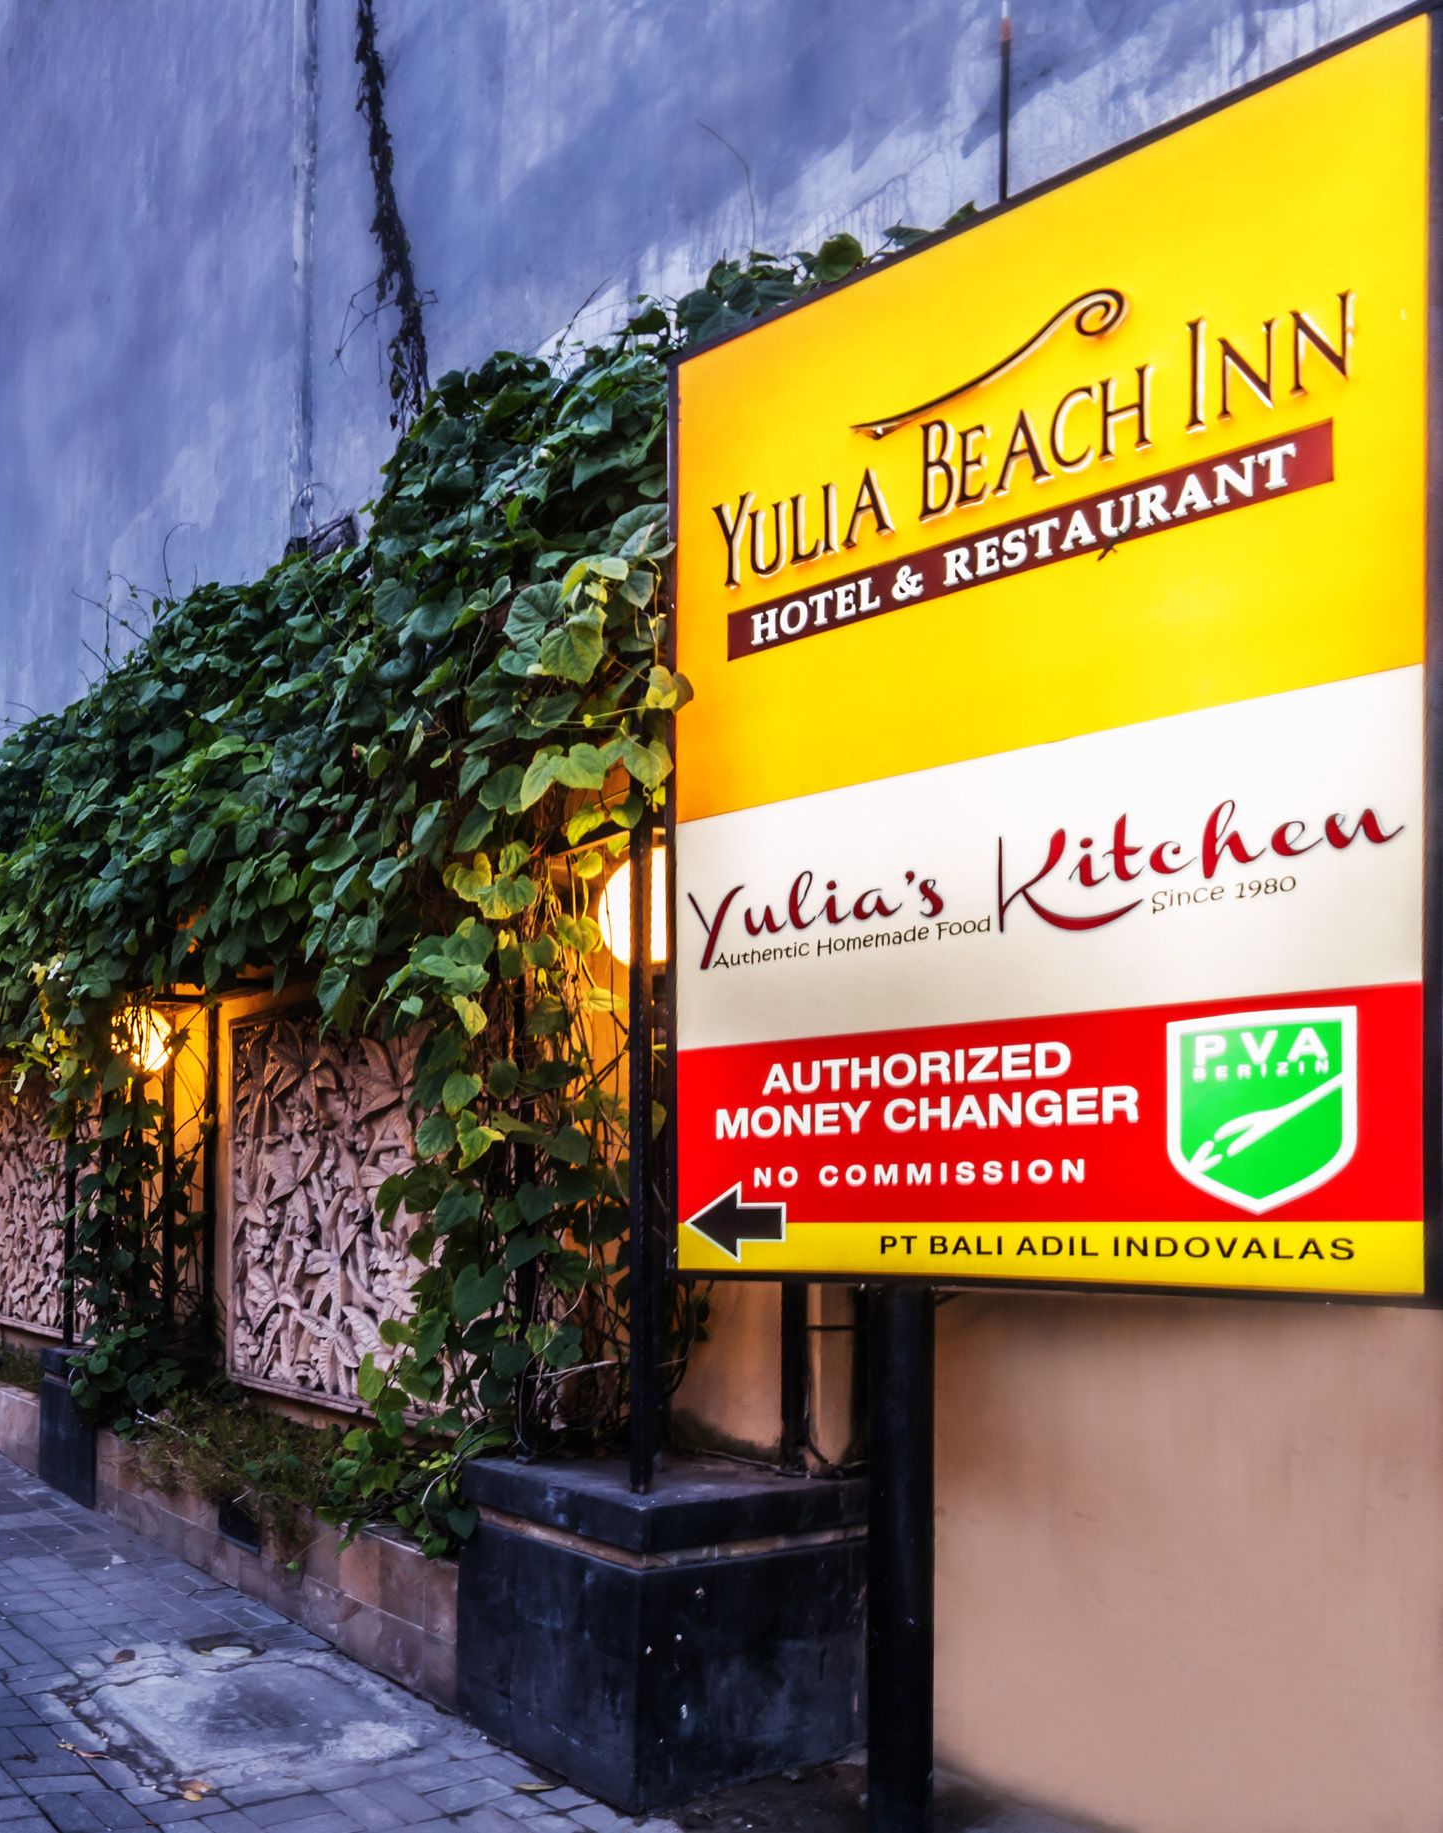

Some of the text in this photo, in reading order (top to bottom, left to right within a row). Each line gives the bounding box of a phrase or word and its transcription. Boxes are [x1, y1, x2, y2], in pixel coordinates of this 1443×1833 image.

[712, 290, 1357, 588] YULIA BEACH INN
[750, 443, 1297, 648] HOTEL & RESTAURANT
[688, 799, 1405, 970] Yulia's Kitchen
[1152, 875, 1297, 915] Since 1980
[713, 915, 991, 969] Authentic Homemade Food
[761, 1040, 1072, 1097] AUTHORIZED
[1194, 1027, 1329, 1067] PVA
[713, 1084, 1140, 1142] MONEY CHANGER
[752, 1157, 1086, 1189] NO COMMISSION
[878, 1233, 1356, 1263] PT BALI ADIL INDOVALAS
